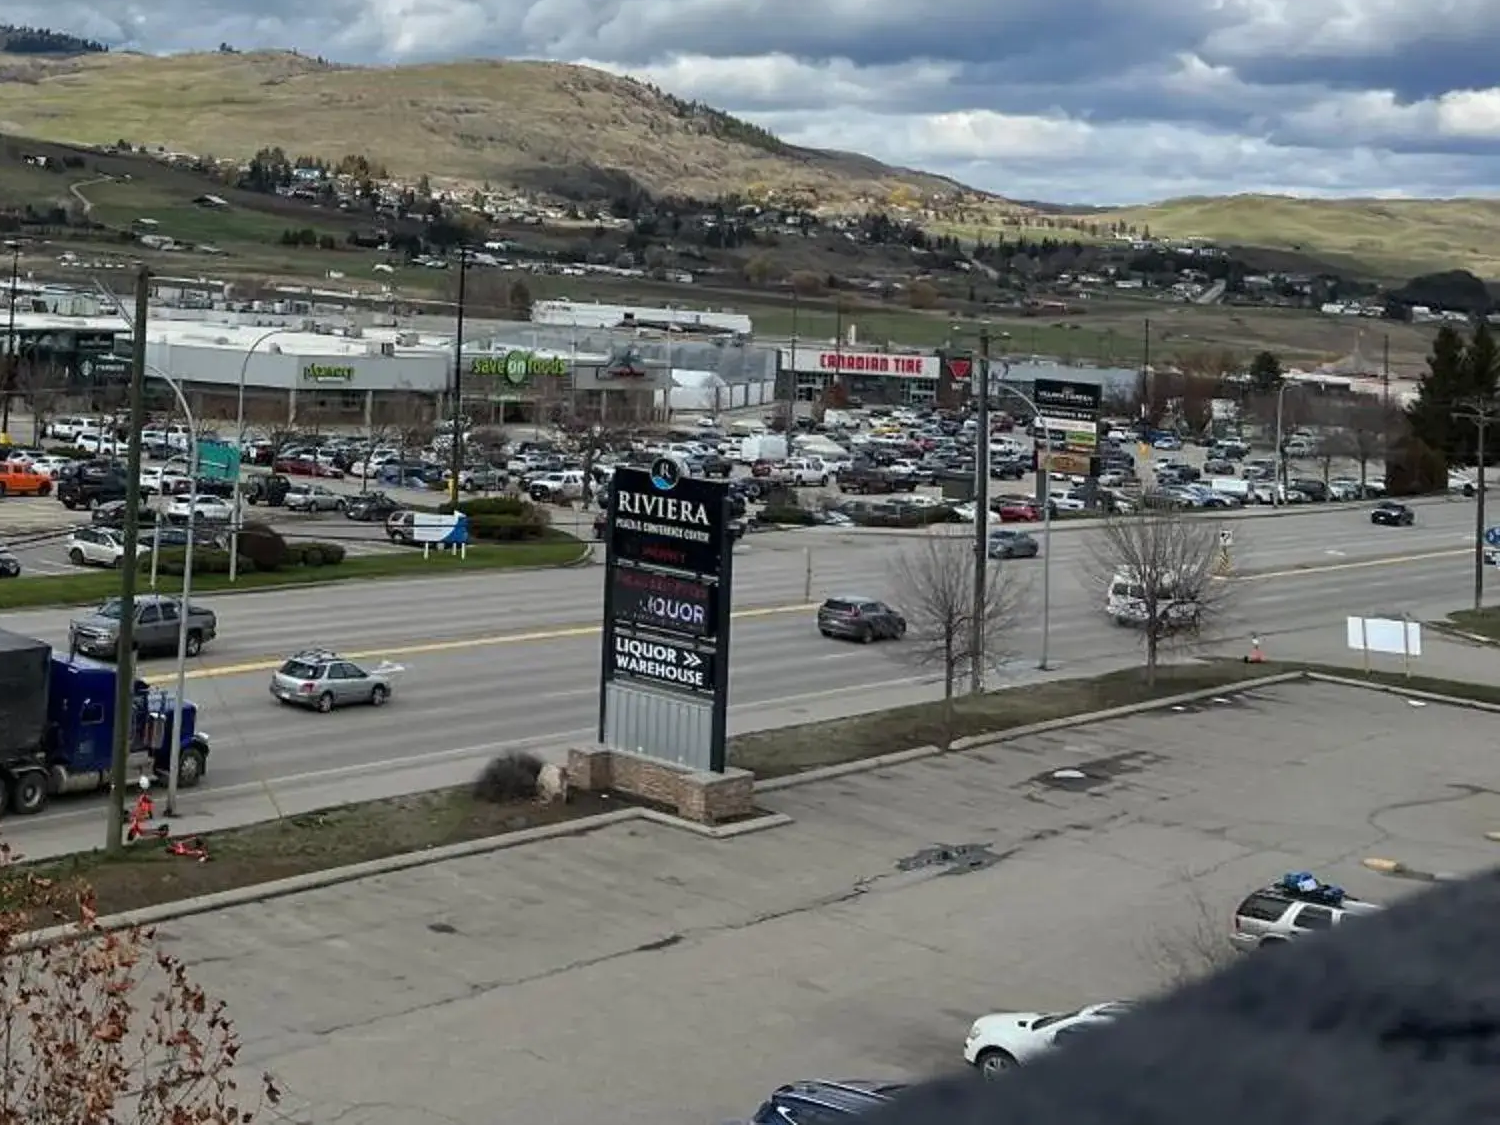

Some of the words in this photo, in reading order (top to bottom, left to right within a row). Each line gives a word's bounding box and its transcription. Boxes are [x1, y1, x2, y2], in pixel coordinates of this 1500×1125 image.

[820, 354, 889, 372] CANADIAN
[894, 357, 923, 374] TIRE
[617, 490, 711, 526] RIVIERA
[615, 637, 677, 664] LIQUOR
[615, 654, 704, 686] WAREHOUSE
